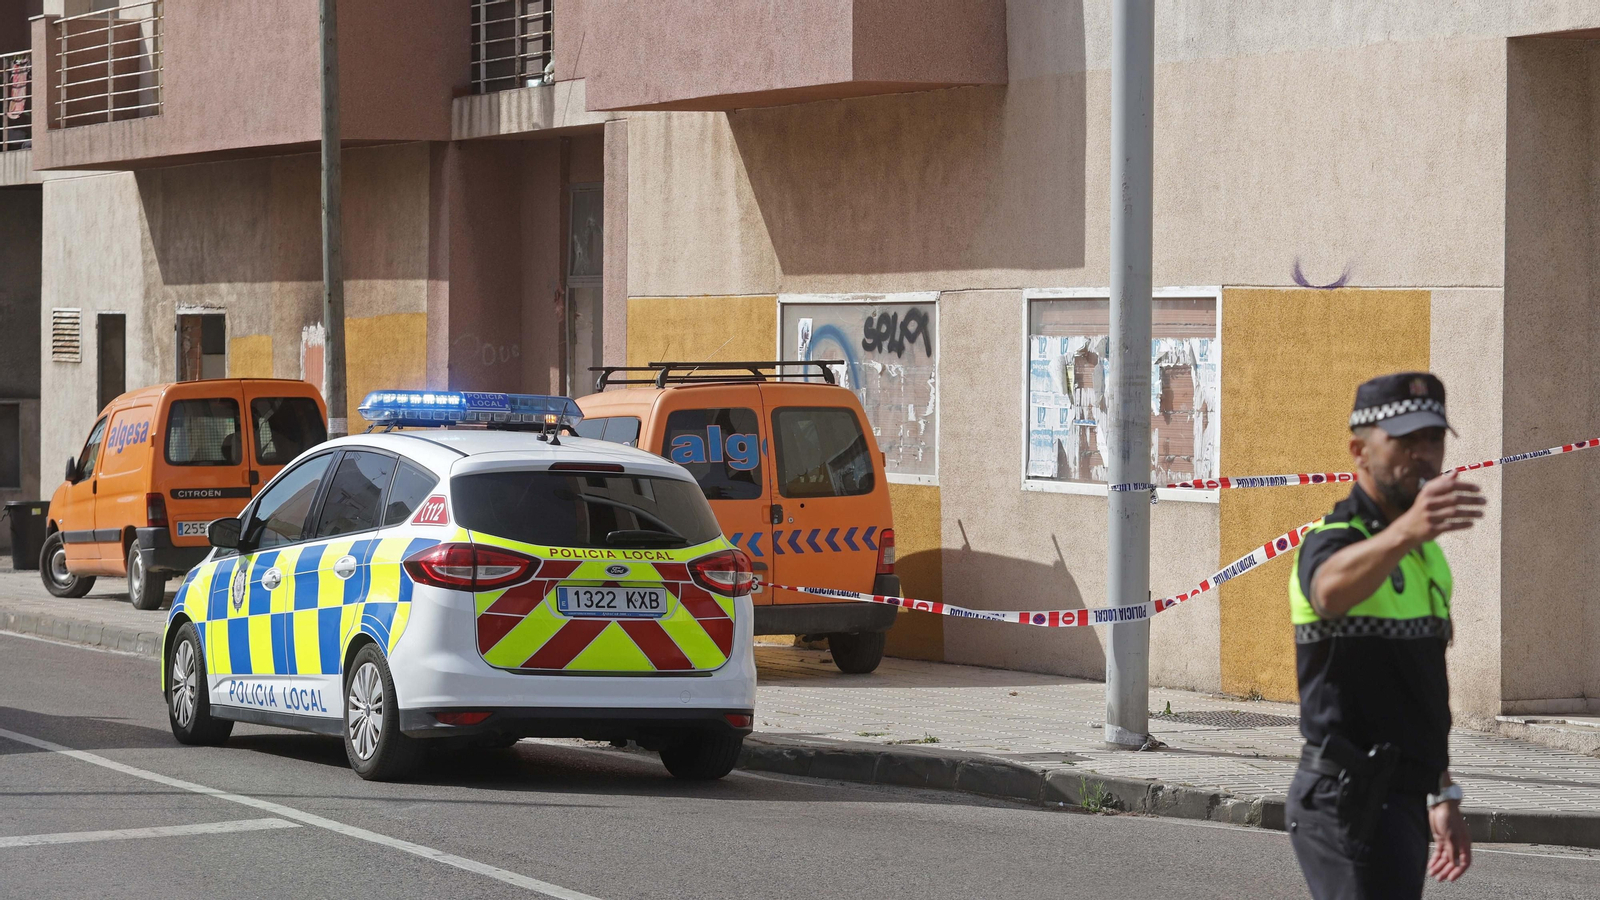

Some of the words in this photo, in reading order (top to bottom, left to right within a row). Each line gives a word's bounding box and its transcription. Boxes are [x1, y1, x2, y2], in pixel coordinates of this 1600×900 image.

[471, 400, 503, 408] LOCAL
[108, 419, 149, 454] algesa
[178, 489, 222, 498] CITROËN
[425, 502, 445, 521] 112
[549, 548, 617, 559] POLICIA
[622, 550, 675, 561] LOCAL
[1236, 554, 1257, 573] LOCAL
[574, 590, 617, 609] 1322
[626, 591, 660, 610] KXB
[1093, 609, 1118, 623] LOCAL
[1118, 605, 1147, 621] POLICIA
[229, 680, 278, 707] POLICIA
[283, 687, 328, 712] LOCAL
